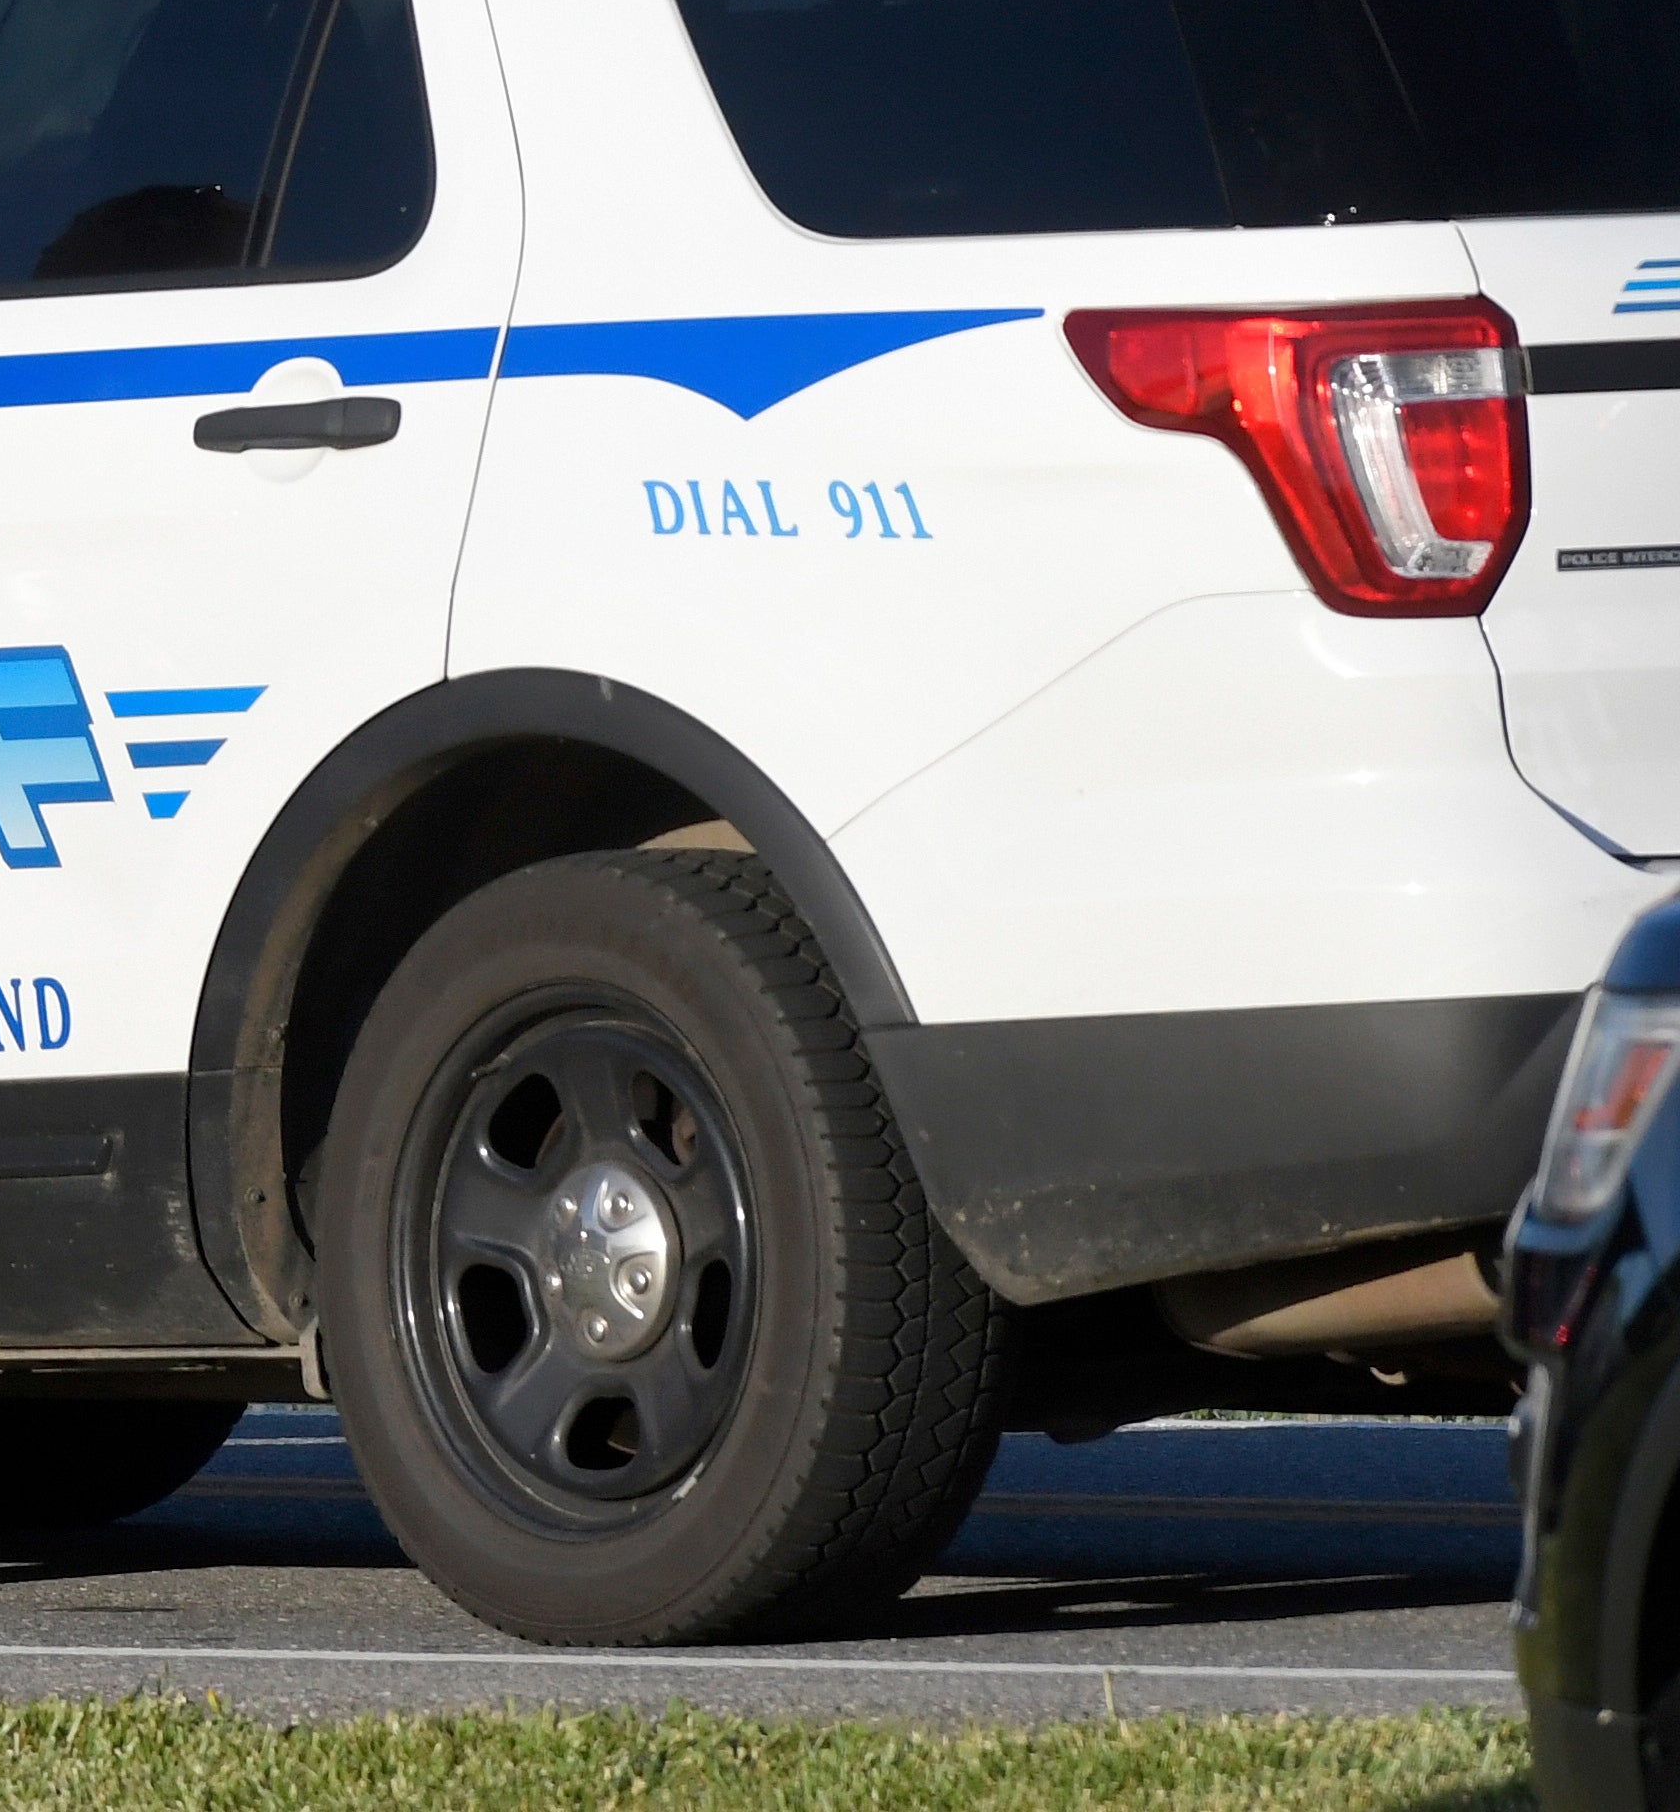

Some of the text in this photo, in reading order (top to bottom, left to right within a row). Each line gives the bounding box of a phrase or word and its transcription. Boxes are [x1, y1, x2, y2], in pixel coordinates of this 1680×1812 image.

[643, 478, 933, 541] DIAL 911
[1561, 551, 1618, 566] POLICE
